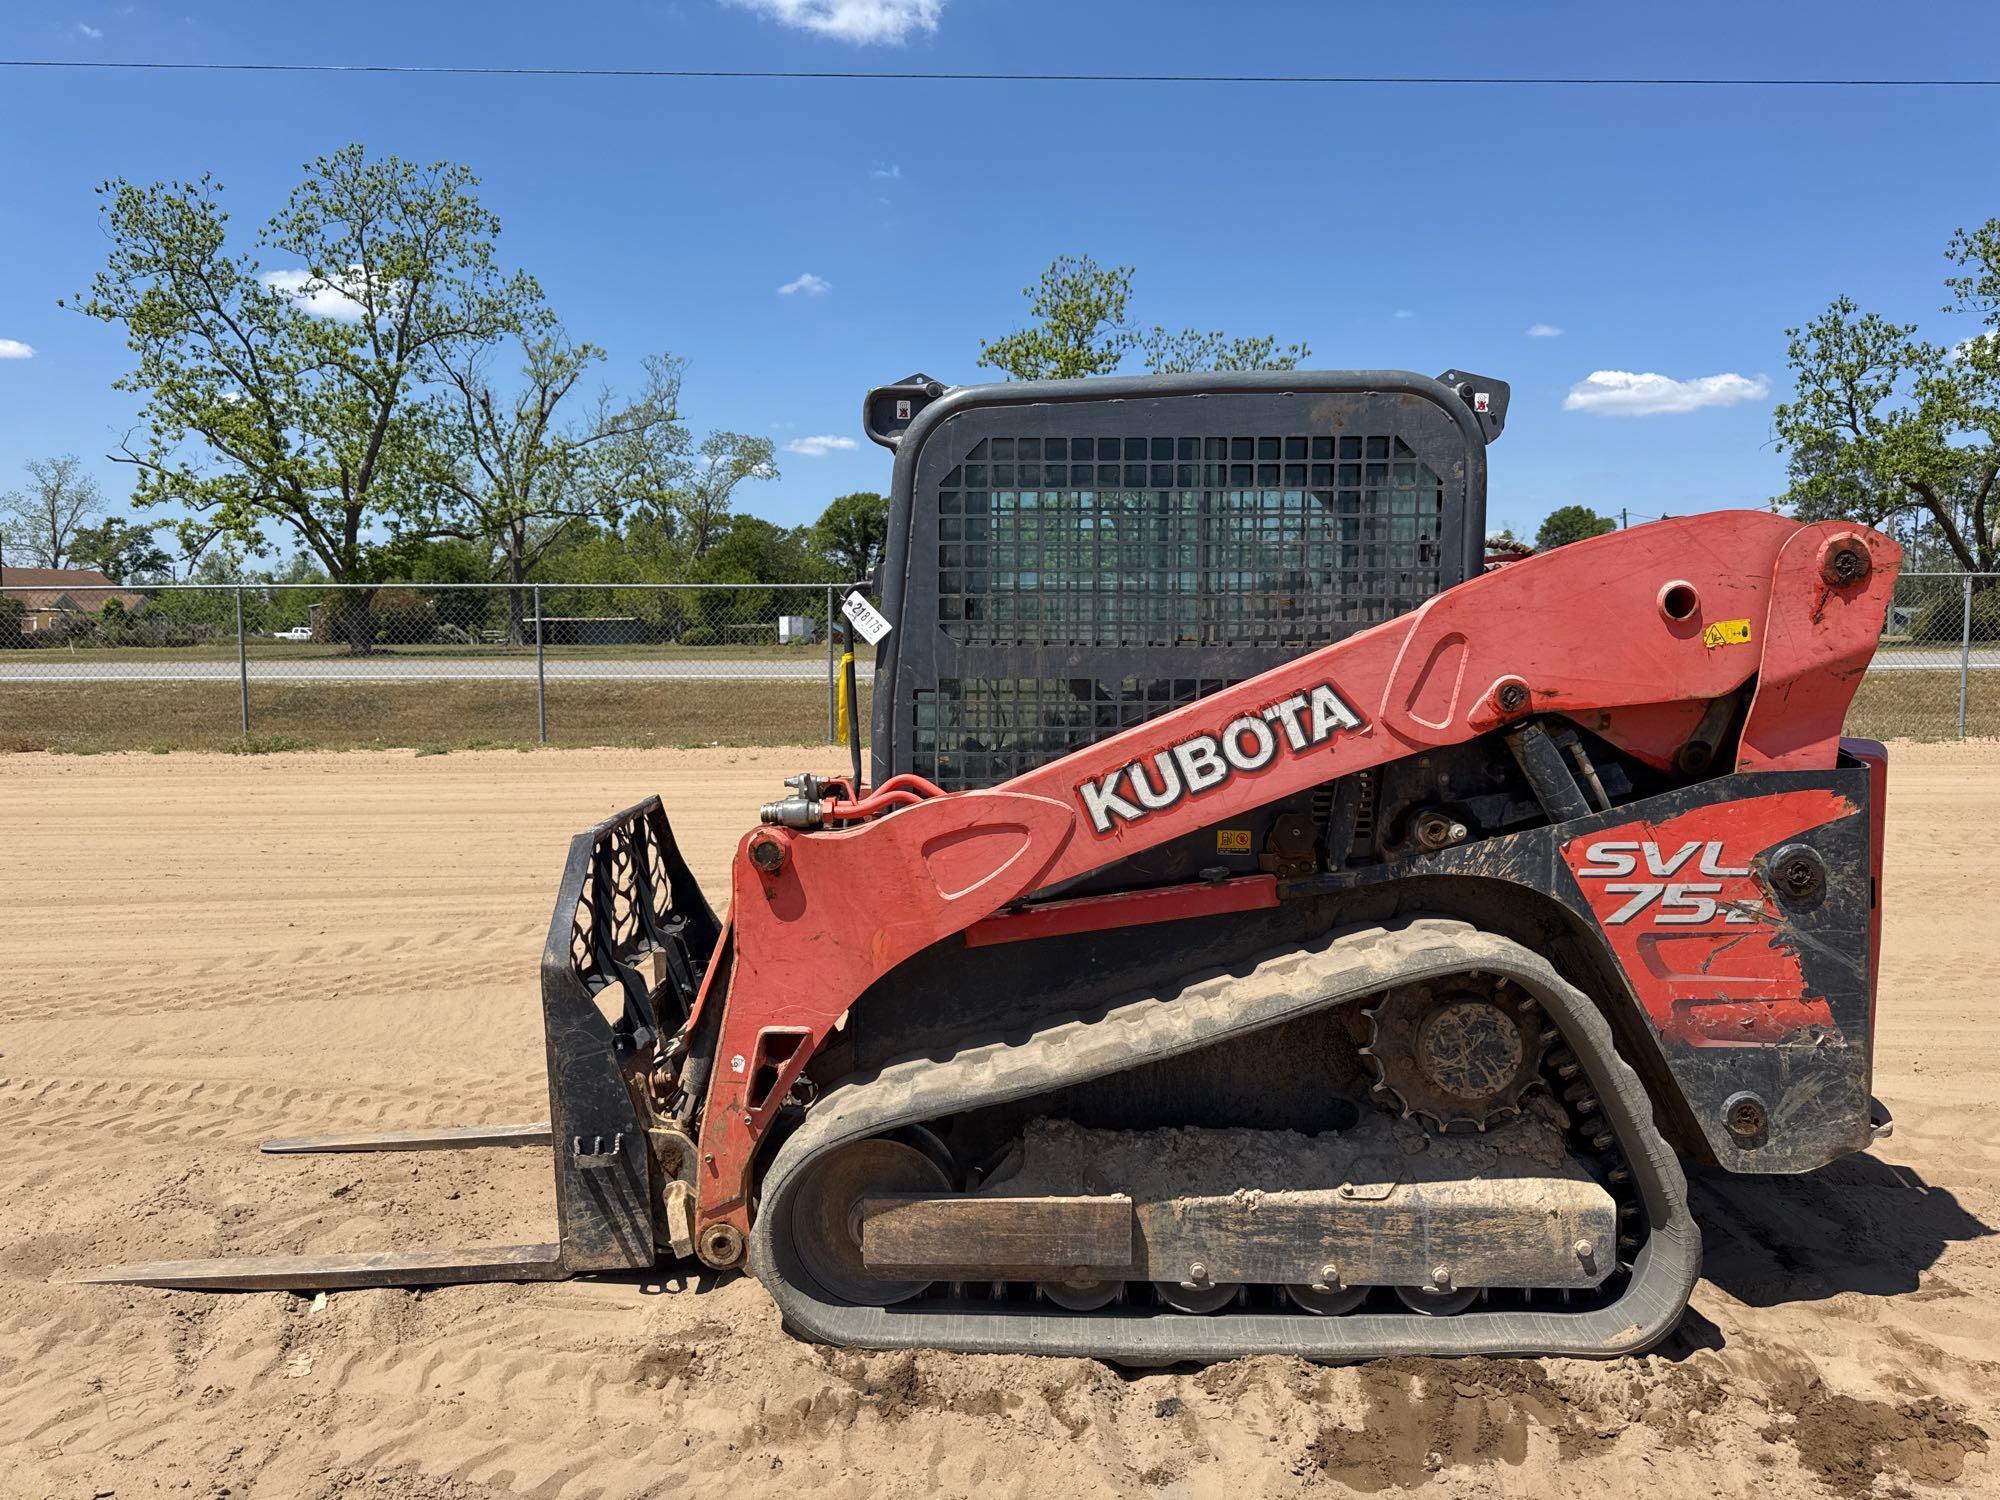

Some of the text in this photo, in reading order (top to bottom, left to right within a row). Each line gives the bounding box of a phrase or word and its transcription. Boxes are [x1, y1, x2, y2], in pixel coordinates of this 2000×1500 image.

[852, 603, 883, 633] 218175
[1080, 685, 1361, 833] KUBOTA
[1578, 841, 1750, 878] SVL
